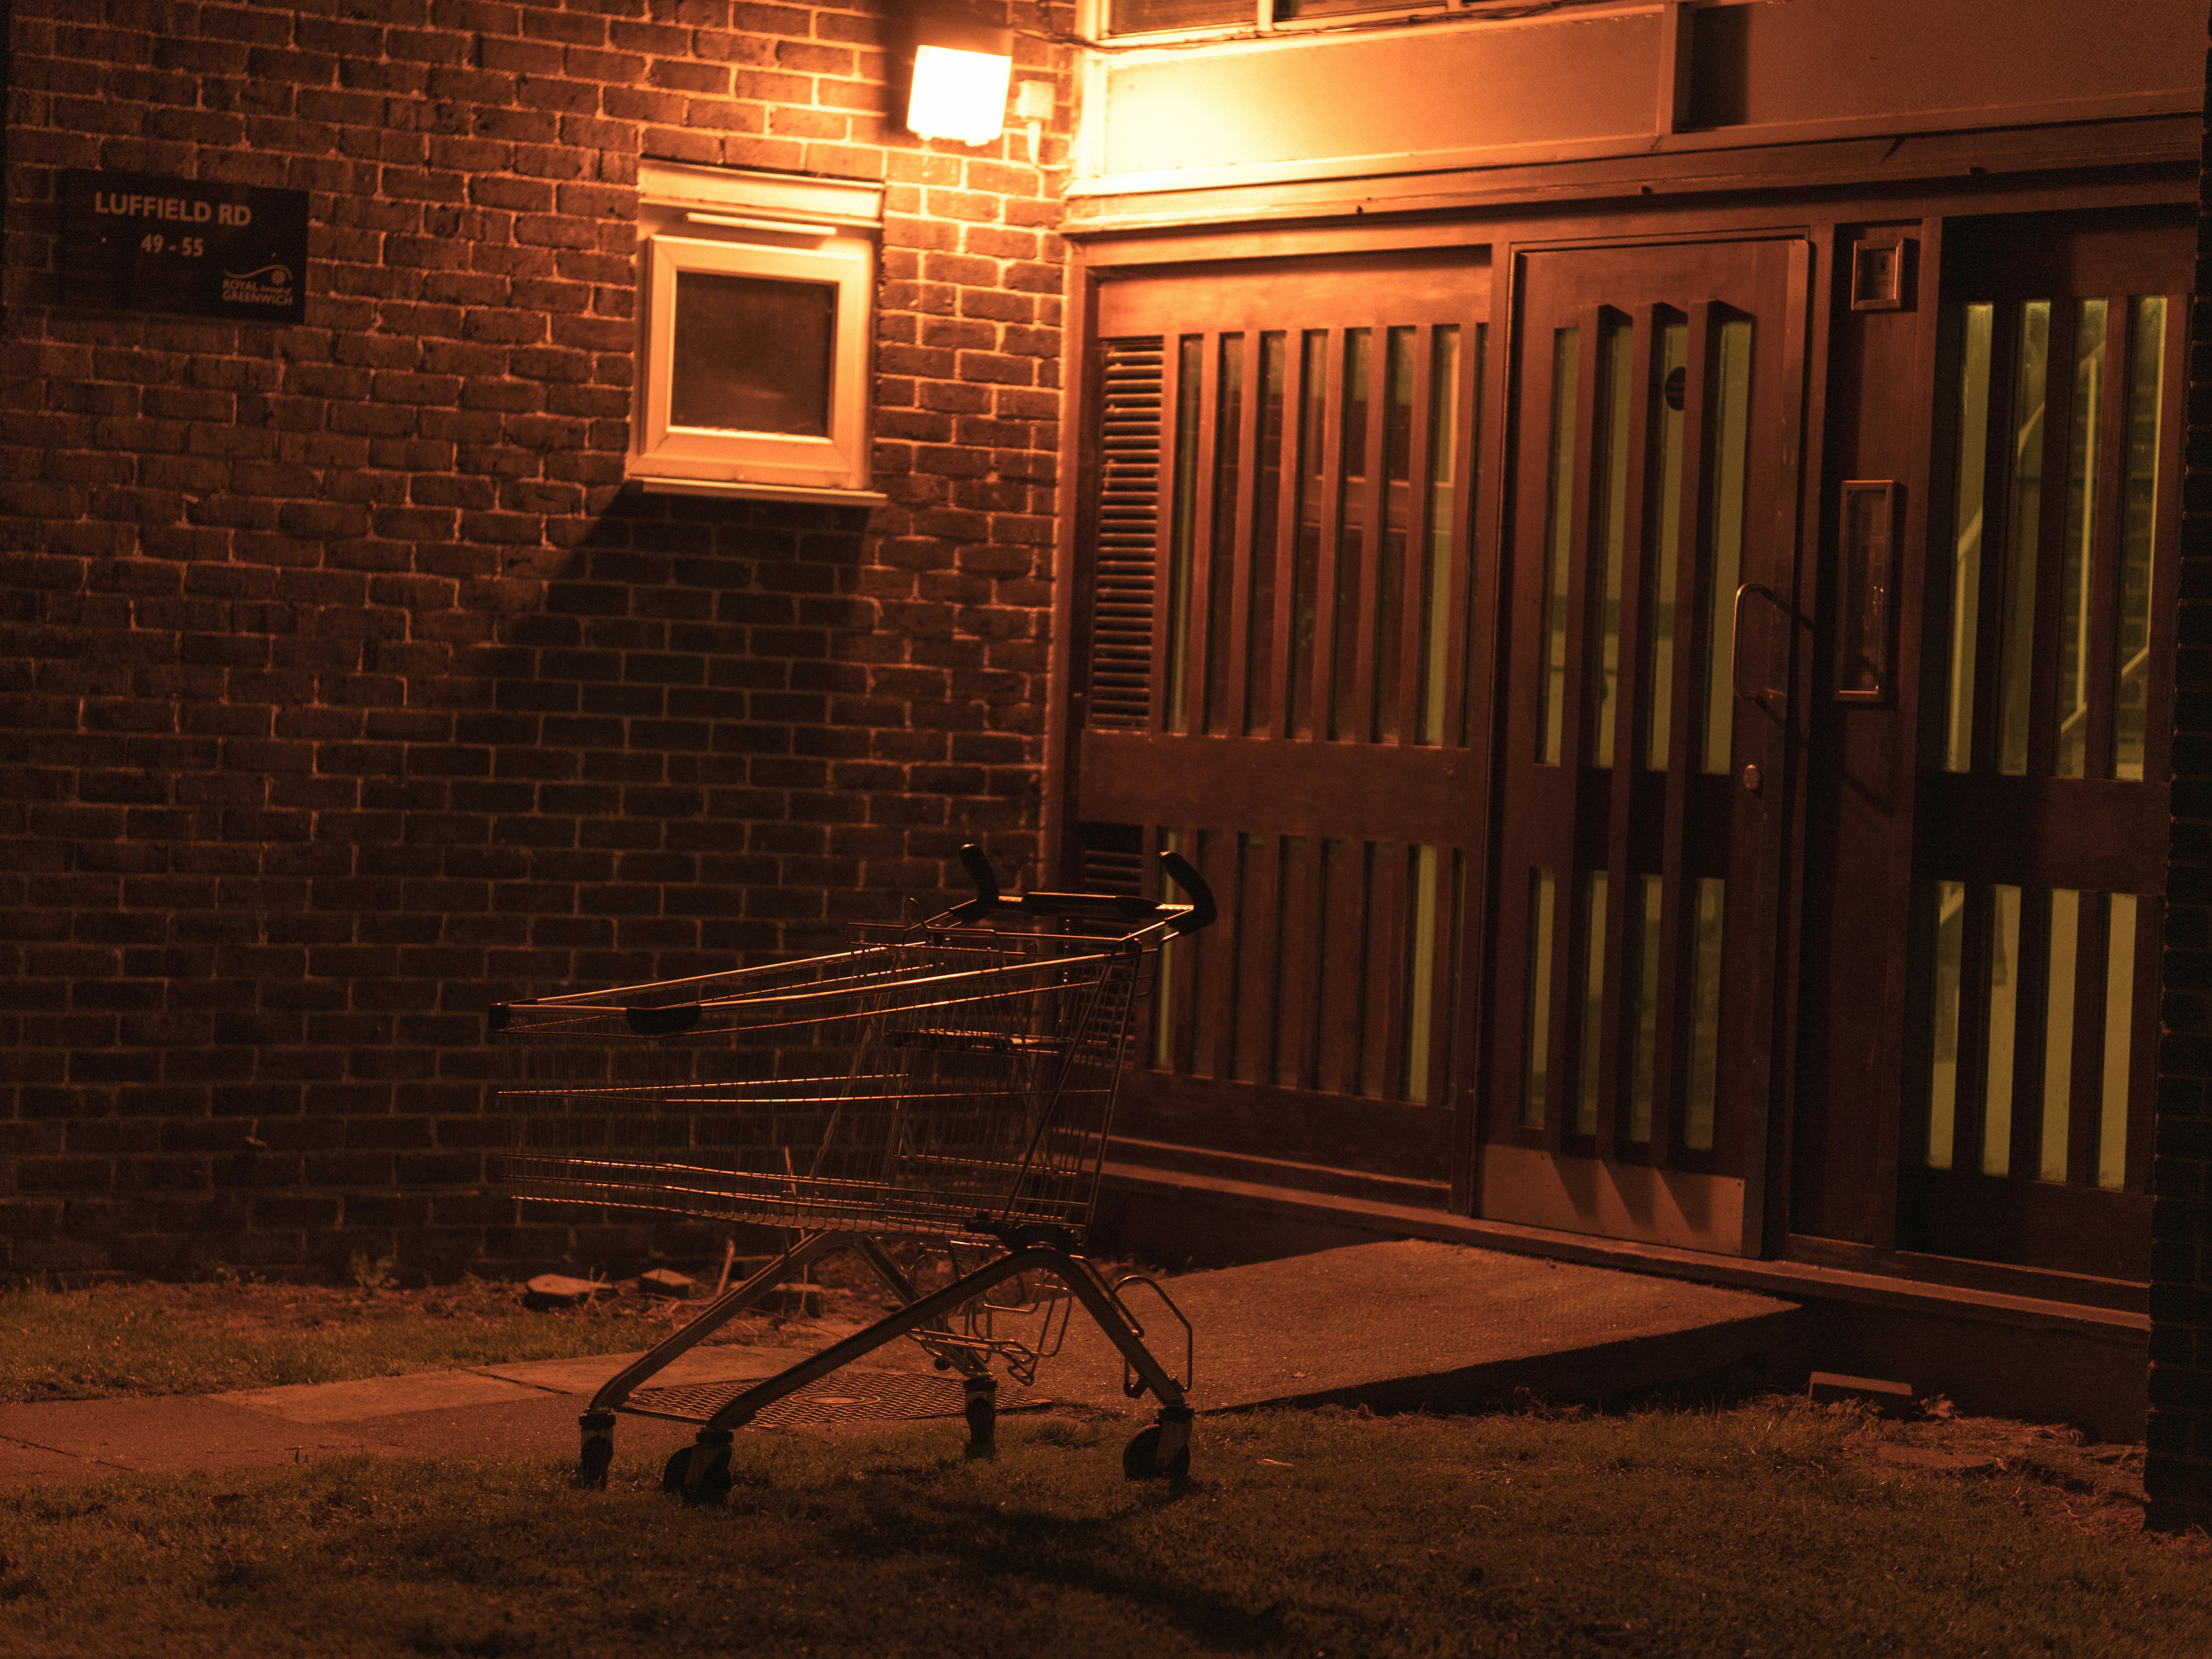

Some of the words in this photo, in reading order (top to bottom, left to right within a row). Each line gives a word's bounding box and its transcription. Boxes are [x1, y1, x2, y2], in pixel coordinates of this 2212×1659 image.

[94, 191, 212, 223] LUFFIELD
[218, 202, 252, 227] RD
[141, 233, 164, 254] 49
[181, 236, 204, 257] 55
[222, 278, 258, 293] ROYAL
[222, 289, 294, 307] GREENWICH
